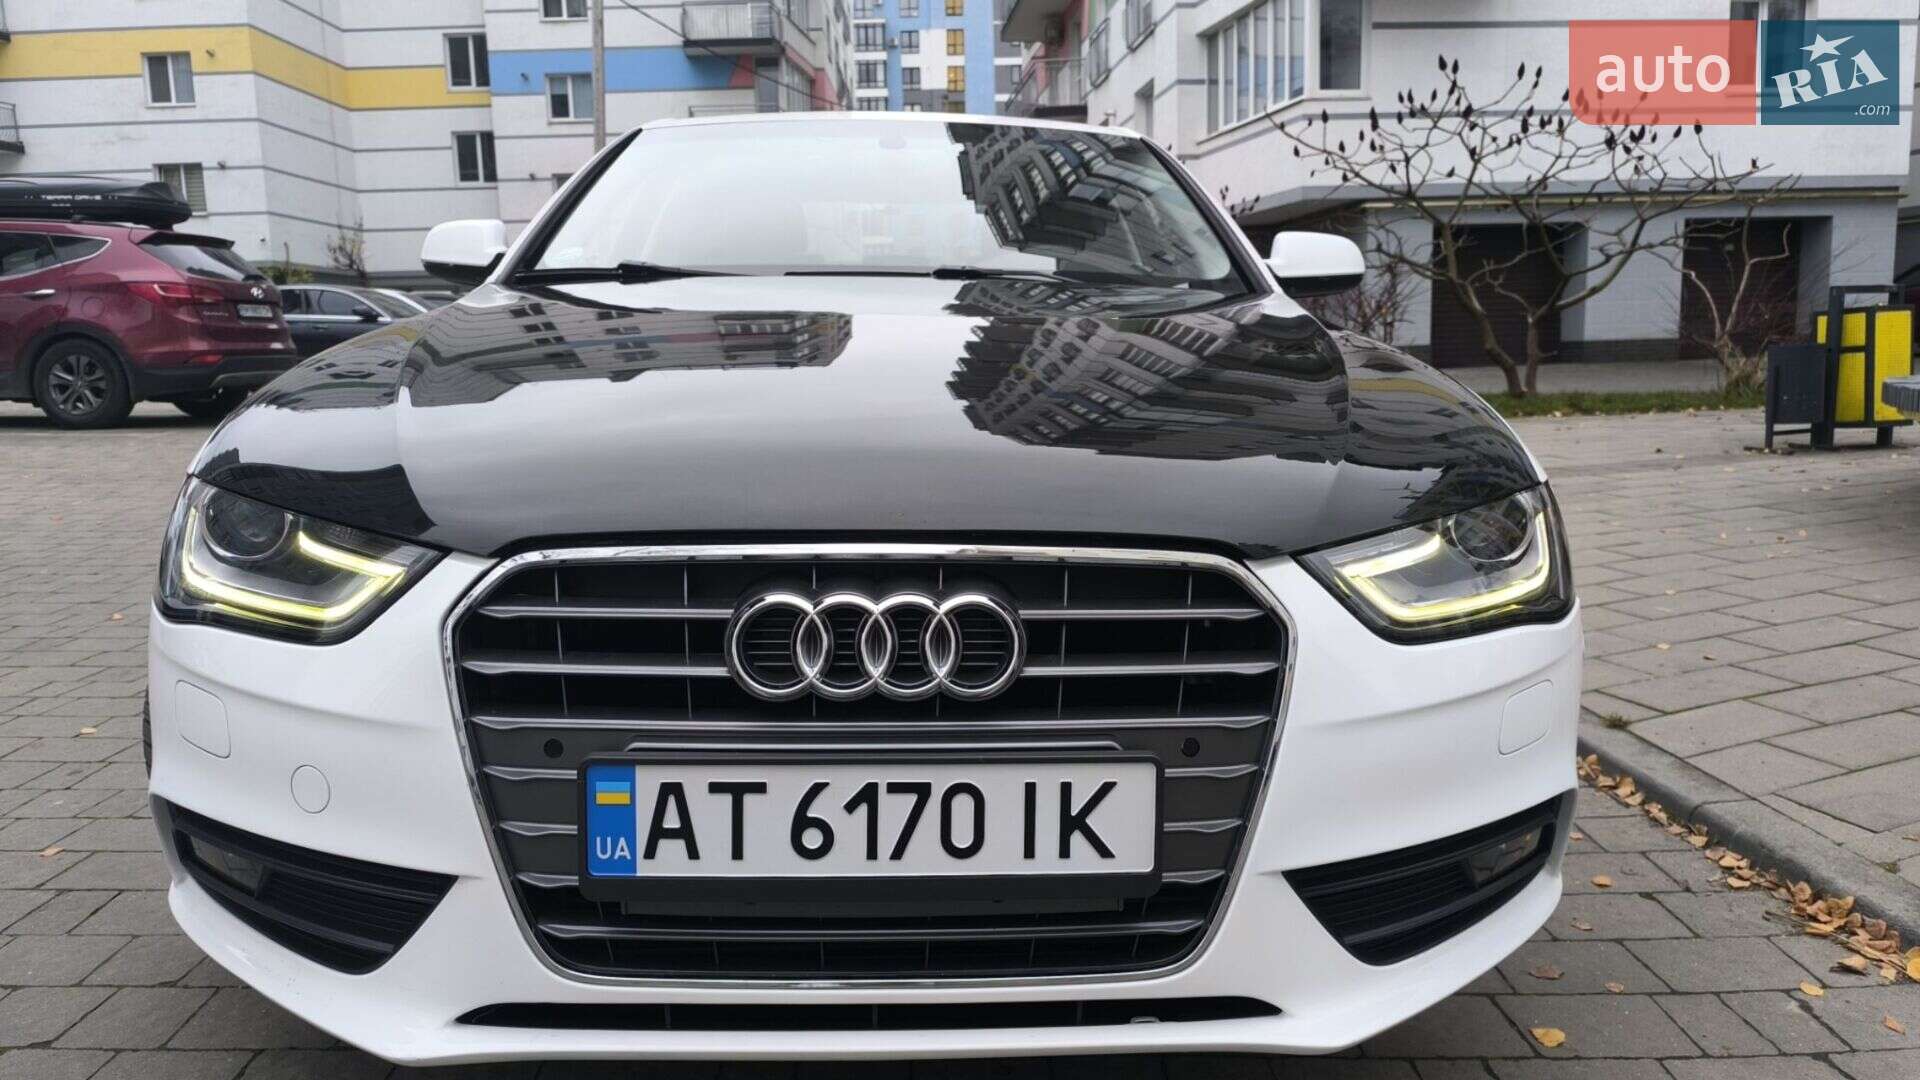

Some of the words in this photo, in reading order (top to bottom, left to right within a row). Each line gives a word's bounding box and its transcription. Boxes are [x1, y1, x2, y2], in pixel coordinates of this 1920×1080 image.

[642, 781, 768, 860] AT
[789, 781, 986, 860] 6170
[1023, 780, 1118, 860] IK
[596, 837, 632, 860] UA
